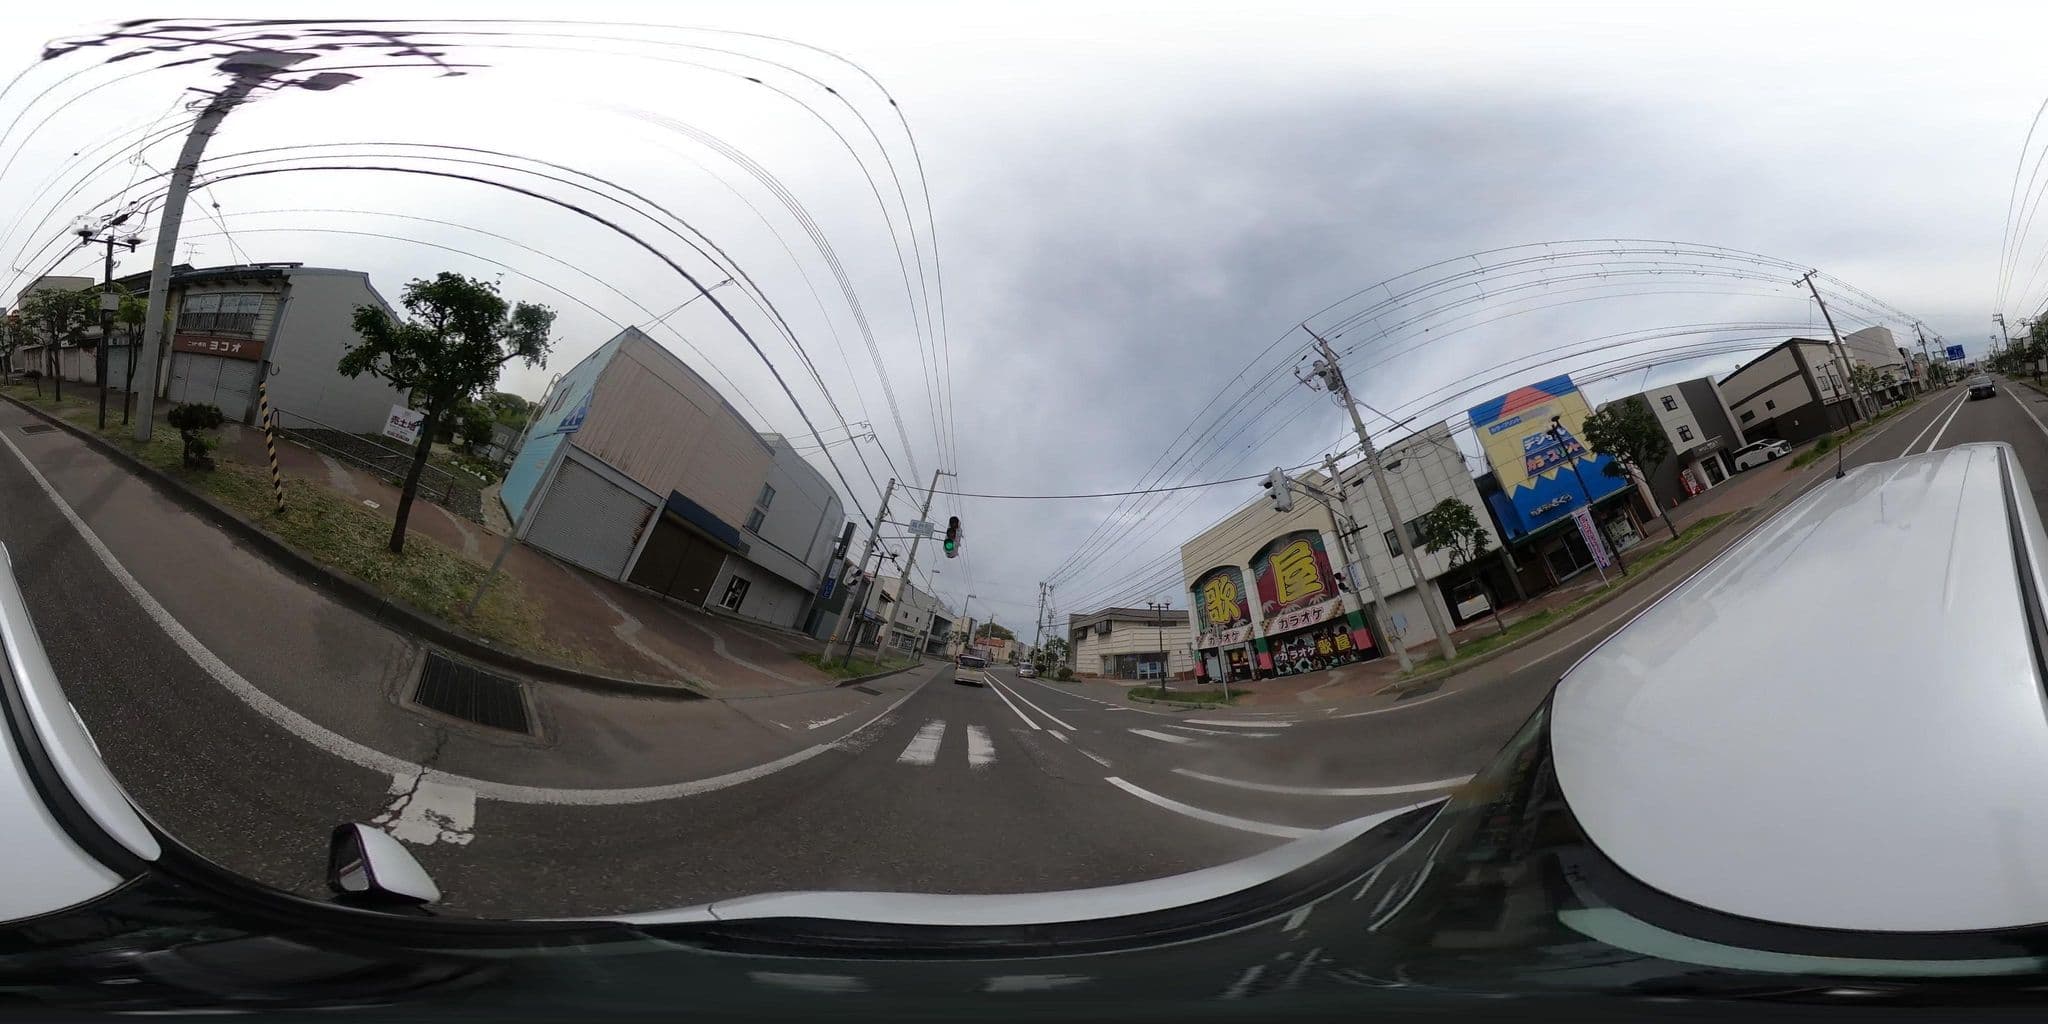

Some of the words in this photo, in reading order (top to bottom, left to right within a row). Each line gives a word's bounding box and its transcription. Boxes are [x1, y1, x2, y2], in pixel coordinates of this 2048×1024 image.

[209, 340, 241, 353] ヨコオ
[390, 415, 417, 432] 売土地
[1203, 574, 1242, 624] 歌
[1269, 540, 1324, 605] 屋
[1278, 607, 1322, 631] カラオケ
[1279, 645, 1317, 662] カラオケ
